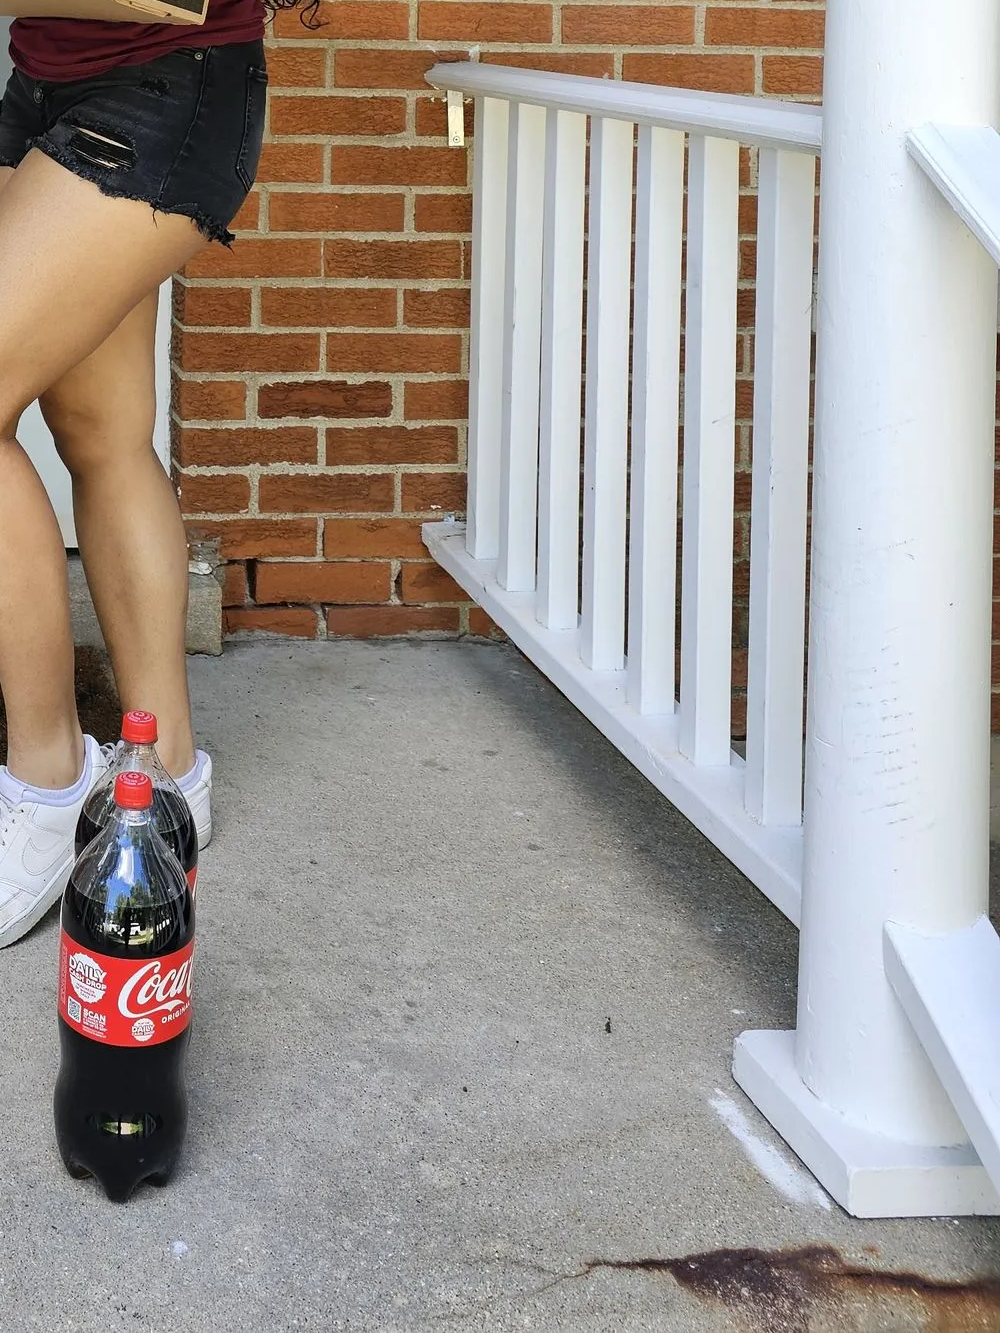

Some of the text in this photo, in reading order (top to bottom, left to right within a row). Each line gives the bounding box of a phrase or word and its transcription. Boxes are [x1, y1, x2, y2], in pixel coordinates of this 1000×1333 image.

[70, 954, 107, 983] DAILY
[86, 977, 107, 991] DROP
[83, 1008, 106, 1024] SCAN
